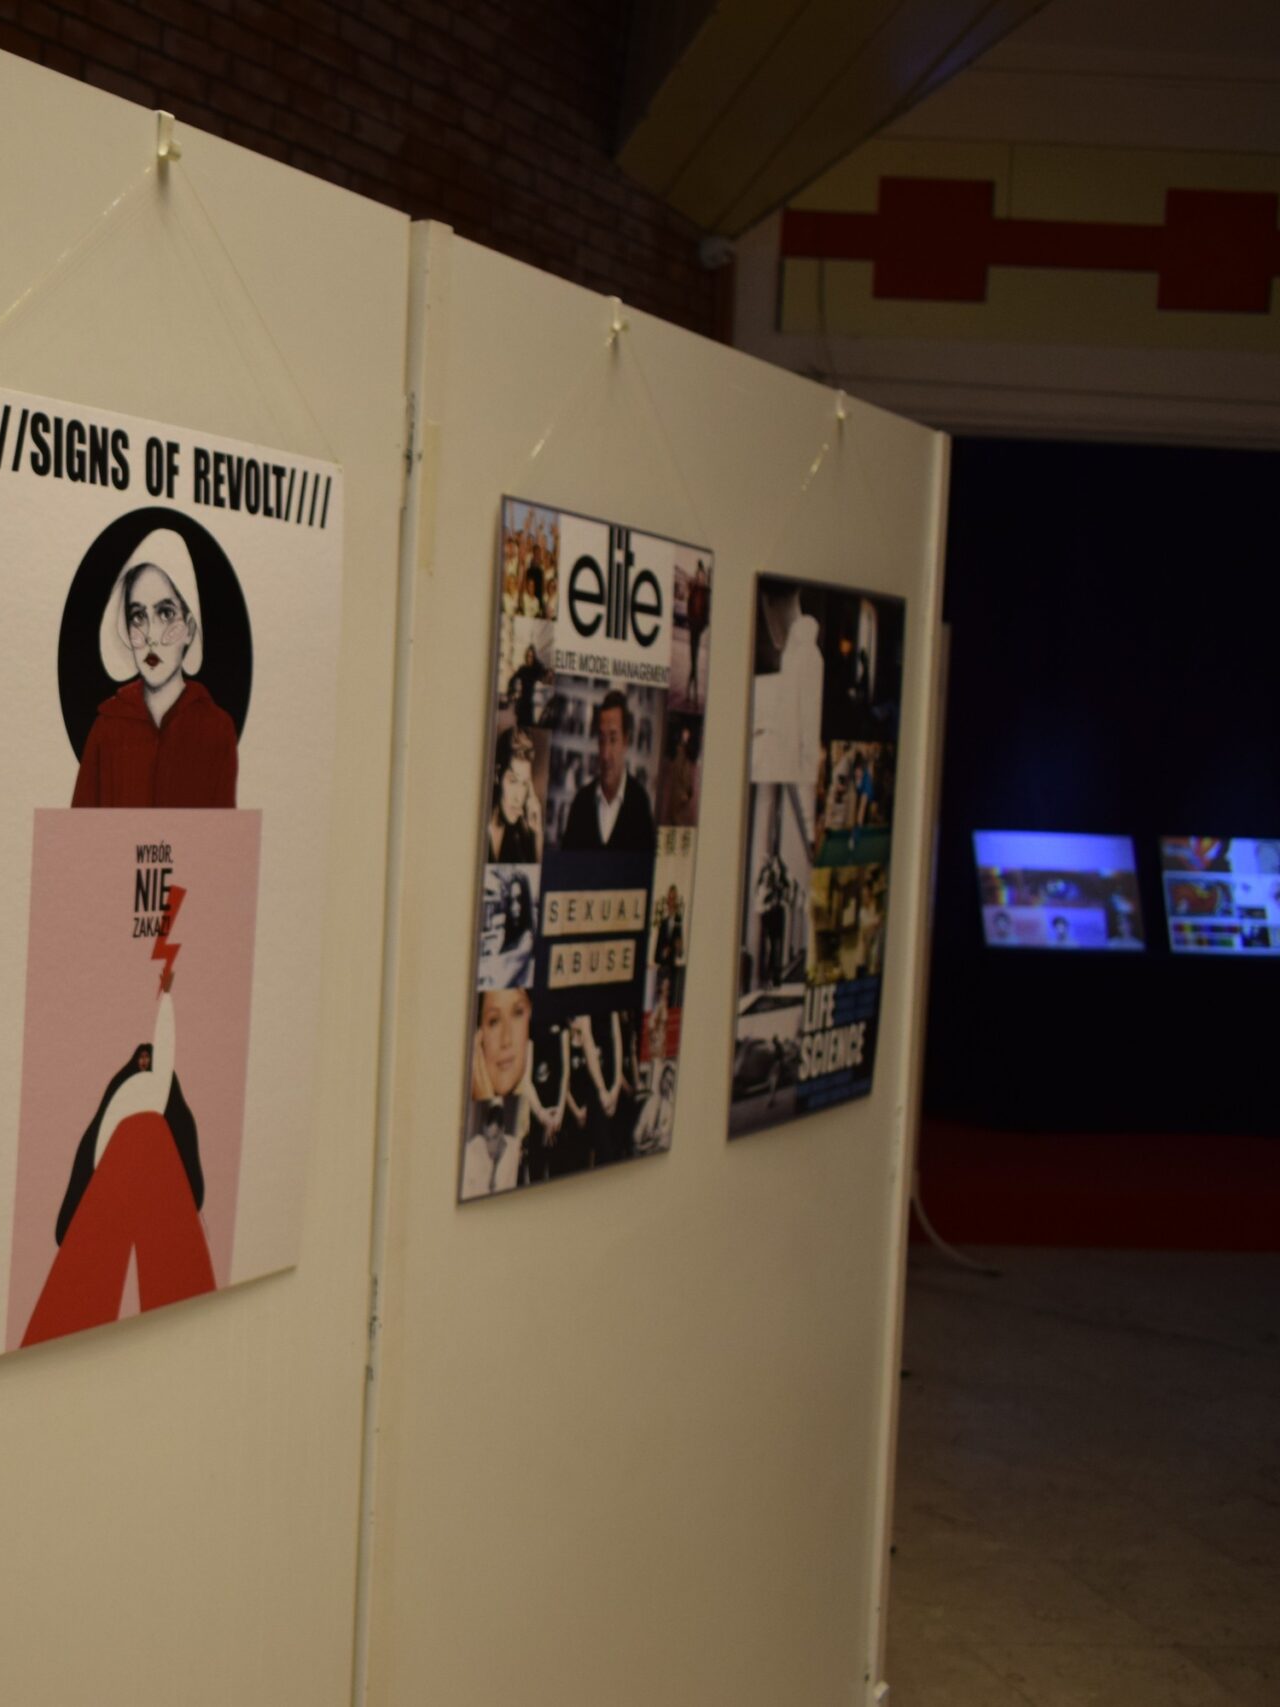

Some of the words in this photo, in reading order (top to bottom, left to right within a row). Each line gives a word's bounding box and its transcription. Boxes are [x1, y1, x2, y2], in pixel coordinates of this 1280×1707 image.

[146, 436, 180, 498] OF
[568, 524, 662, 648] elite
[555, 650, 576, 671] ELITE
[579, 654, 609, 676] MODEL
[612, 659, 669, 682] MANAGEMENT
[134, 868, 173, 913] NIE
[549, 897, 641, 923] SEXUAL
[555, 947, 631, 975] ABUSE
[804, 984, 837, 1032] LIFE
[799, 1021, 866, 1080] SCIENCE
